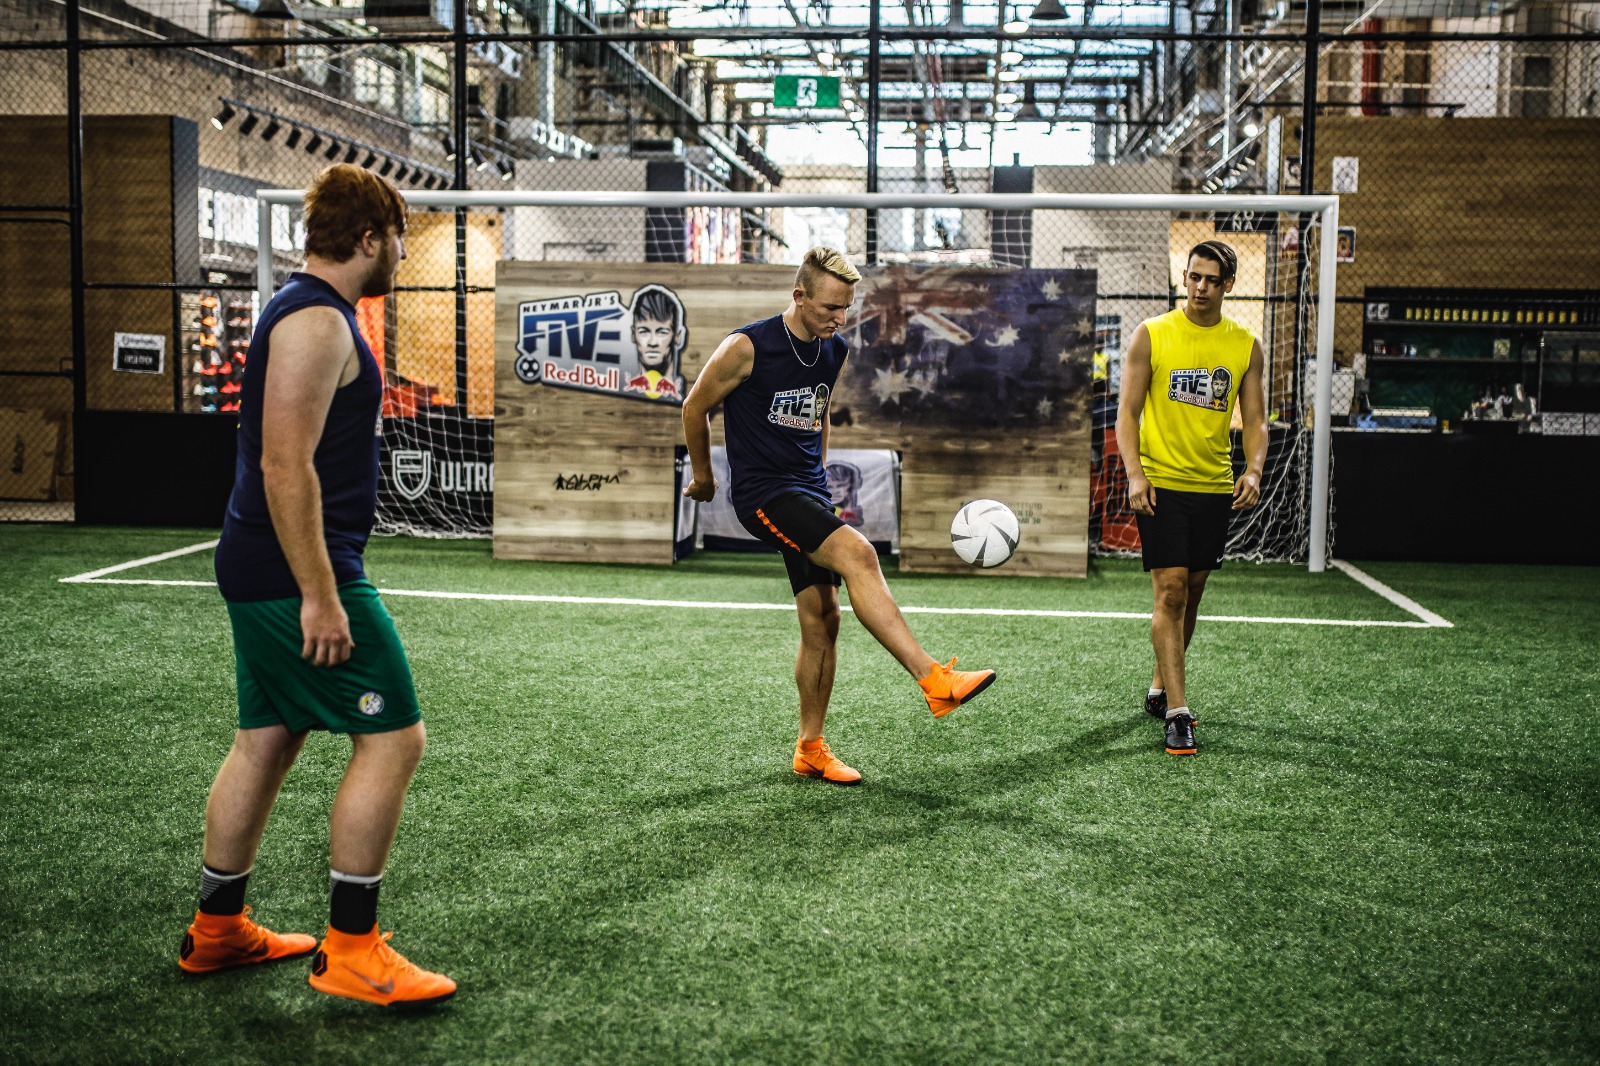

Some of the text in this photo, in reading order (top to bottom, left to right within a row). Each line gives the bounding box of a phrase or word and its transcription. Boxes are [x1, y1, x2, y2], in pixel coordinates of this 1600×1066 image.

[523, 295, 616, 313] NEYMAR JR'S
[523, 308, 625, 364] FIVE
[1172, 375, 1209, 396] FIVE
[773, 394, 813, 418] FIVE
